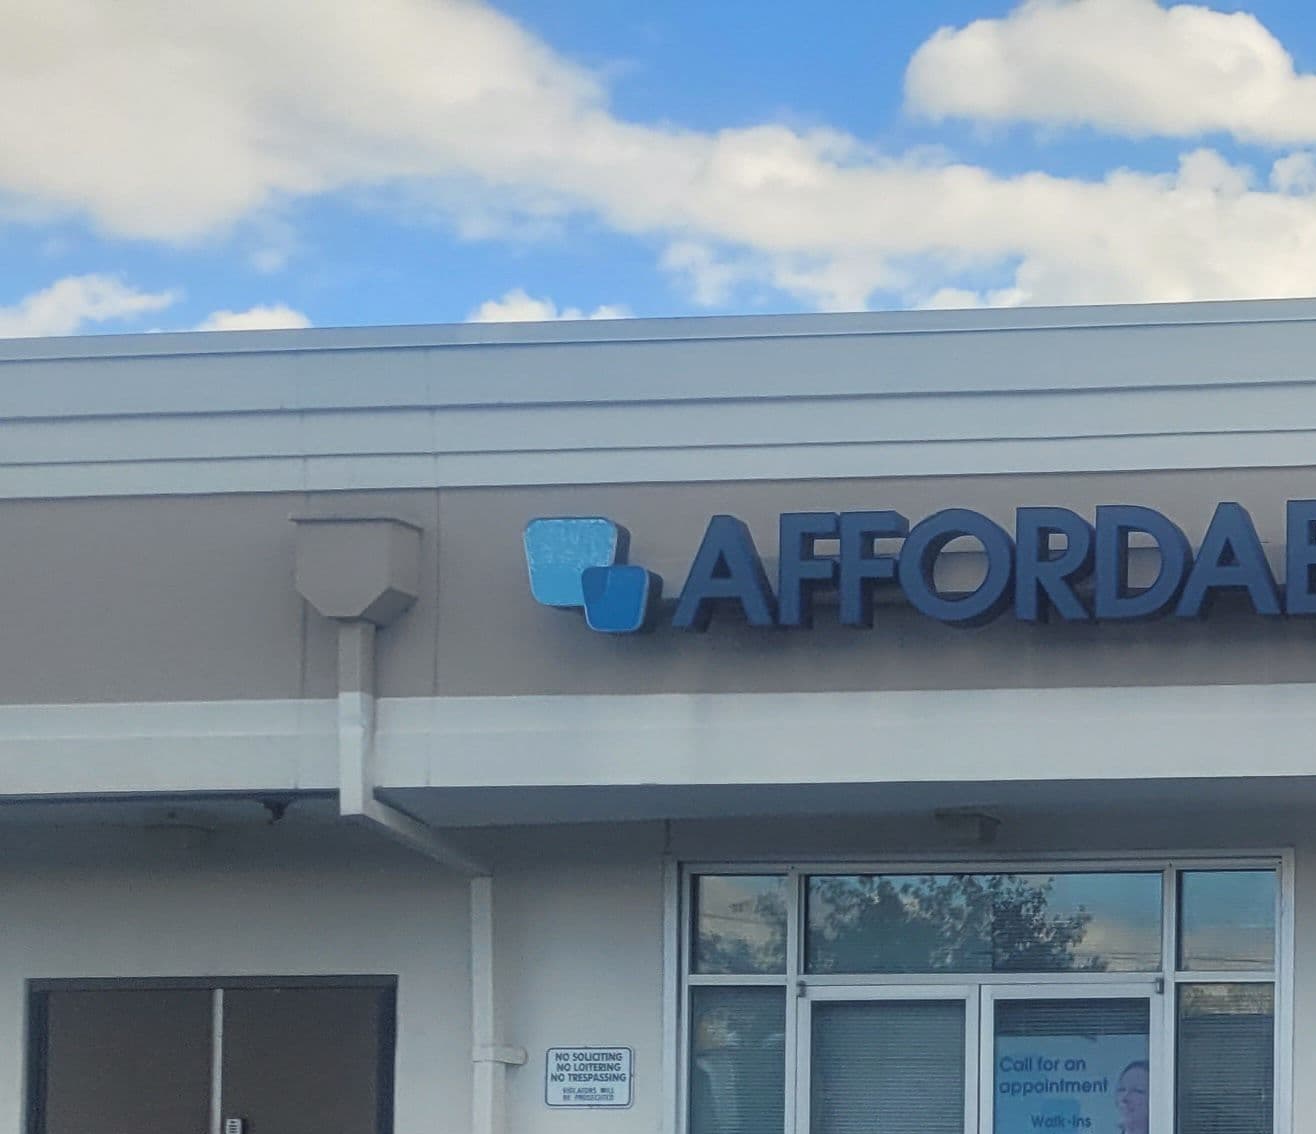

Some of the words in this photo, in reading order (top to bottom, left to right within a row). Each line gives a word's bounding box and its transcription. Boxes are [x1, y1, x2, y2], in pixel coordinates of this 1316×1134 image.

[555, 1053, 570, 1061] NO
[572, 1053, 623, 1061] SOLICITING
[556, 1063, 571, 1071] NO
[573, 1063, 621, 1071] LOITERING
[1000, 1056, 1032, 1072] Call
[1037, 1057, 1059, 1072] for
[1064, 1059, 1086, 1072] an
[551, 1073, 565, 1082] NO
[568, 1073, 627, 1082] TRESPASSING
[1000, 1078, 1109, 1096] appointment
